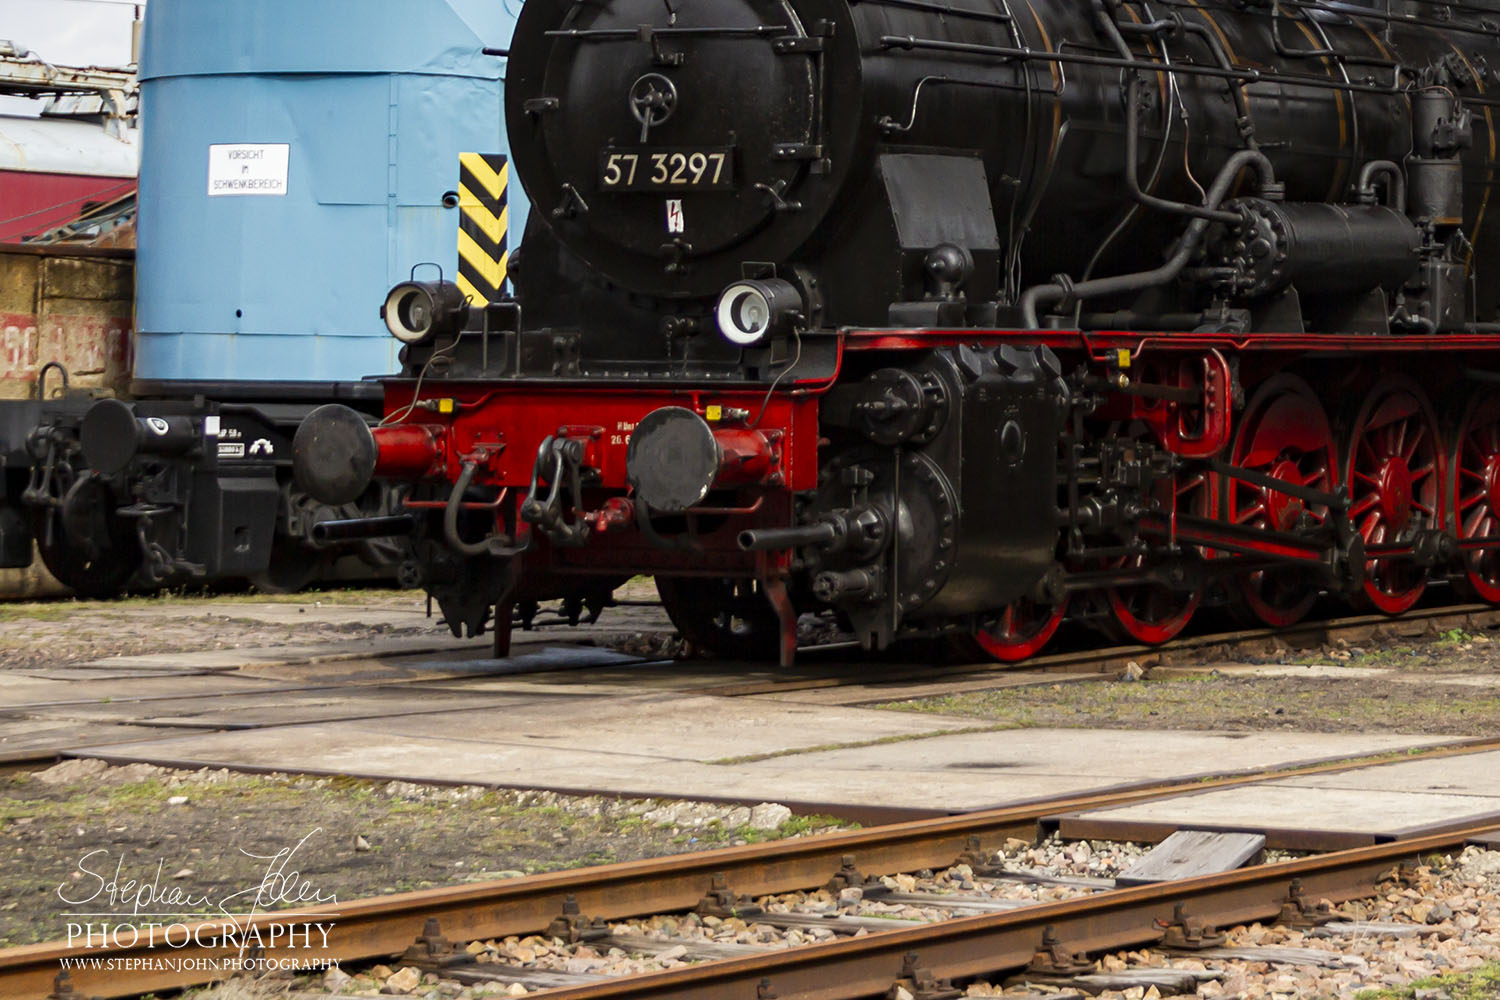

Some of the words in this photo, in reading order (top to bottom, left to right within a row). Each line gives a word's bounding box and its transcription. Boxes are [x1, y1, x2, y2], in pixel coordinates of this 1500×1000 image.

[228, 149, 264, 160] VORSICHT
[603, 153, 639, 186] 57
[650, 152, 725, 185] 3297
[214, 179, 282, 190] SCHWENKBEREICH
